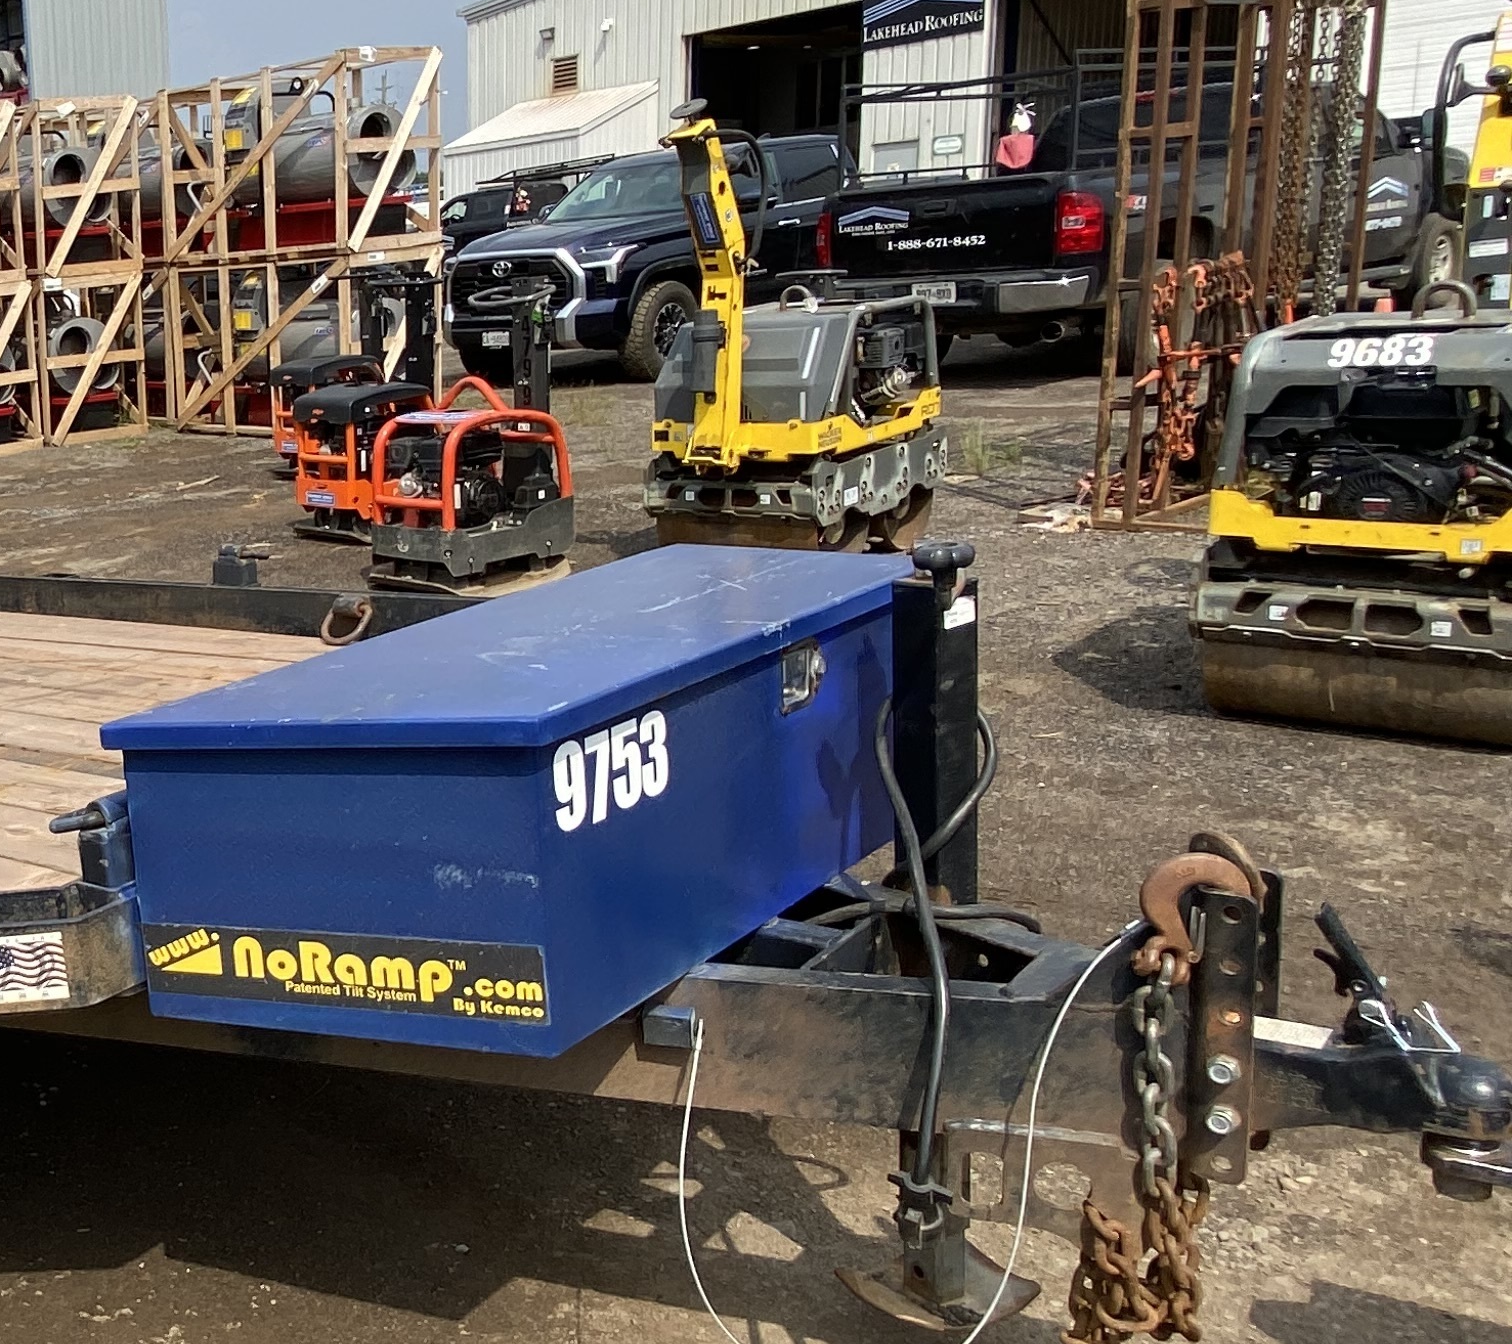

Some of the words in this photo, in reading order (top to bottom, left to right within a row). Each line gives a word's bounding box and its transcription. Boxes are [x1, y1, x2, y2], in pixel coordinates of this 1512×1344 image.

[887, 235, 986, 251] 1-888-671-8452
[1327, 336, 1434, 368] 9683
[553, 710, 669, 832] 9753
[147, 928, 220, 967] www.
[232, 936, 453, 1002] NoRamp
[447, 959, 467, 971] TM
[463, 978, 544, 1002] .com
[285, 980, 341, 996] Patented
[342, 984, 365, 999] Tilt
[366, 986, 417, 1002] System
[453, 998, 476, 1016] By
[480, 1001, 545, 1018] Kemco
